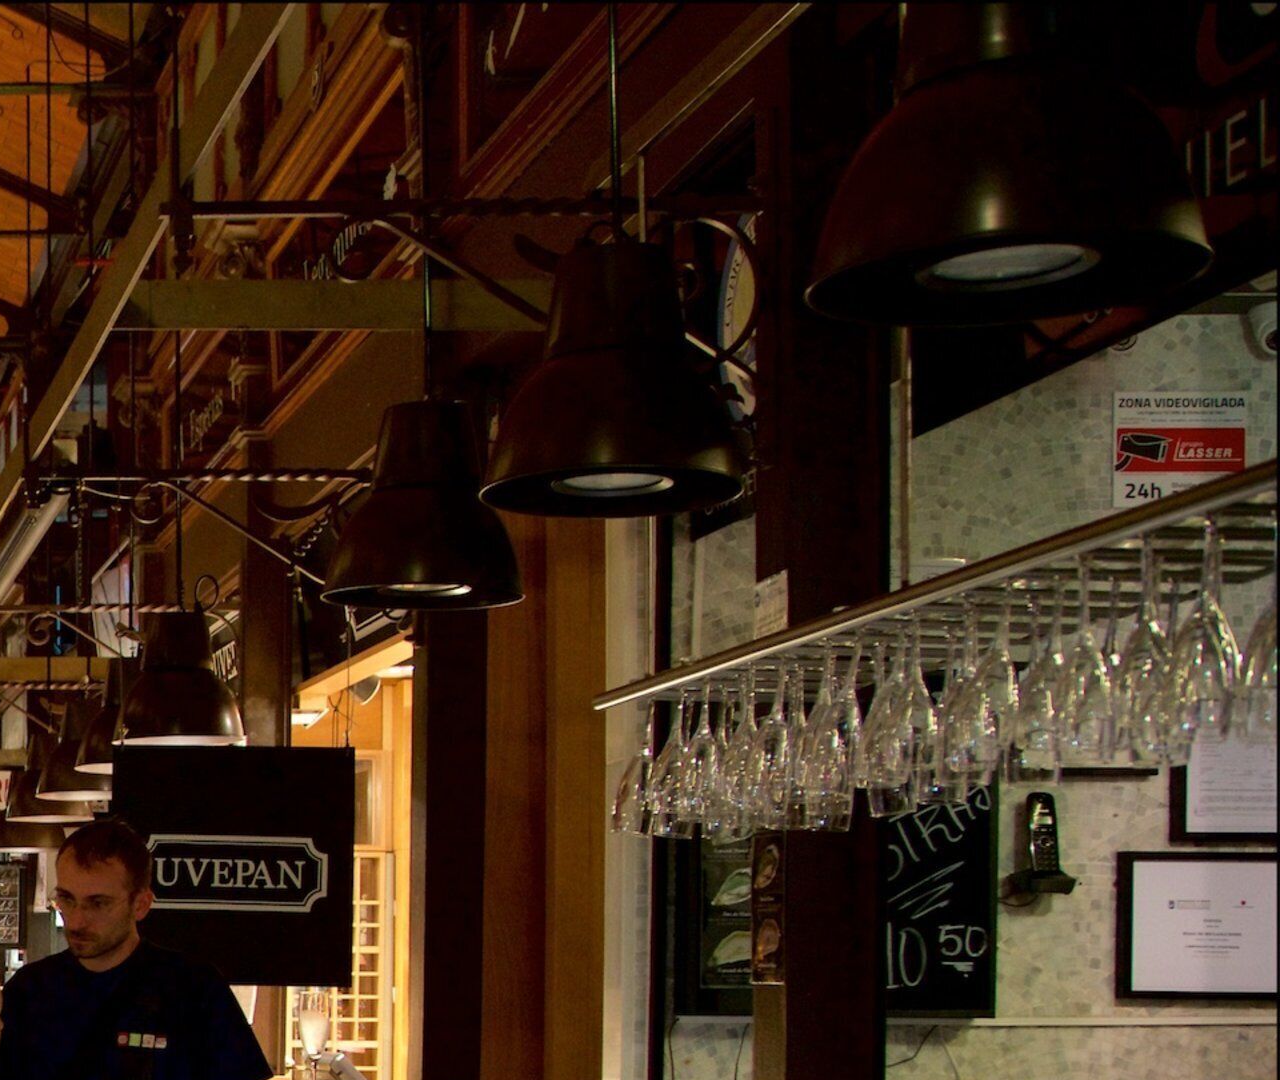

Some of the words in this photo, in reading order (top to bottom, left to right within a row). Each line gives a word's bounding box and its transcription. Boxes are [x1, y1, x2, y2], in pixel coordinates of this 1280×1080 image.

[1118, 398, 1151, 408] ZONA
[1154, 397, 1246, 408] VIDEOVIGILADA
[1178, 447, 1233, 459] LASSER
[1125, 483, 1162, 499] 24h
[154, 856, 307, 890] UVEPAN
[885, 920, 928, 989] 10
[937, 923, 989, 958] 50
